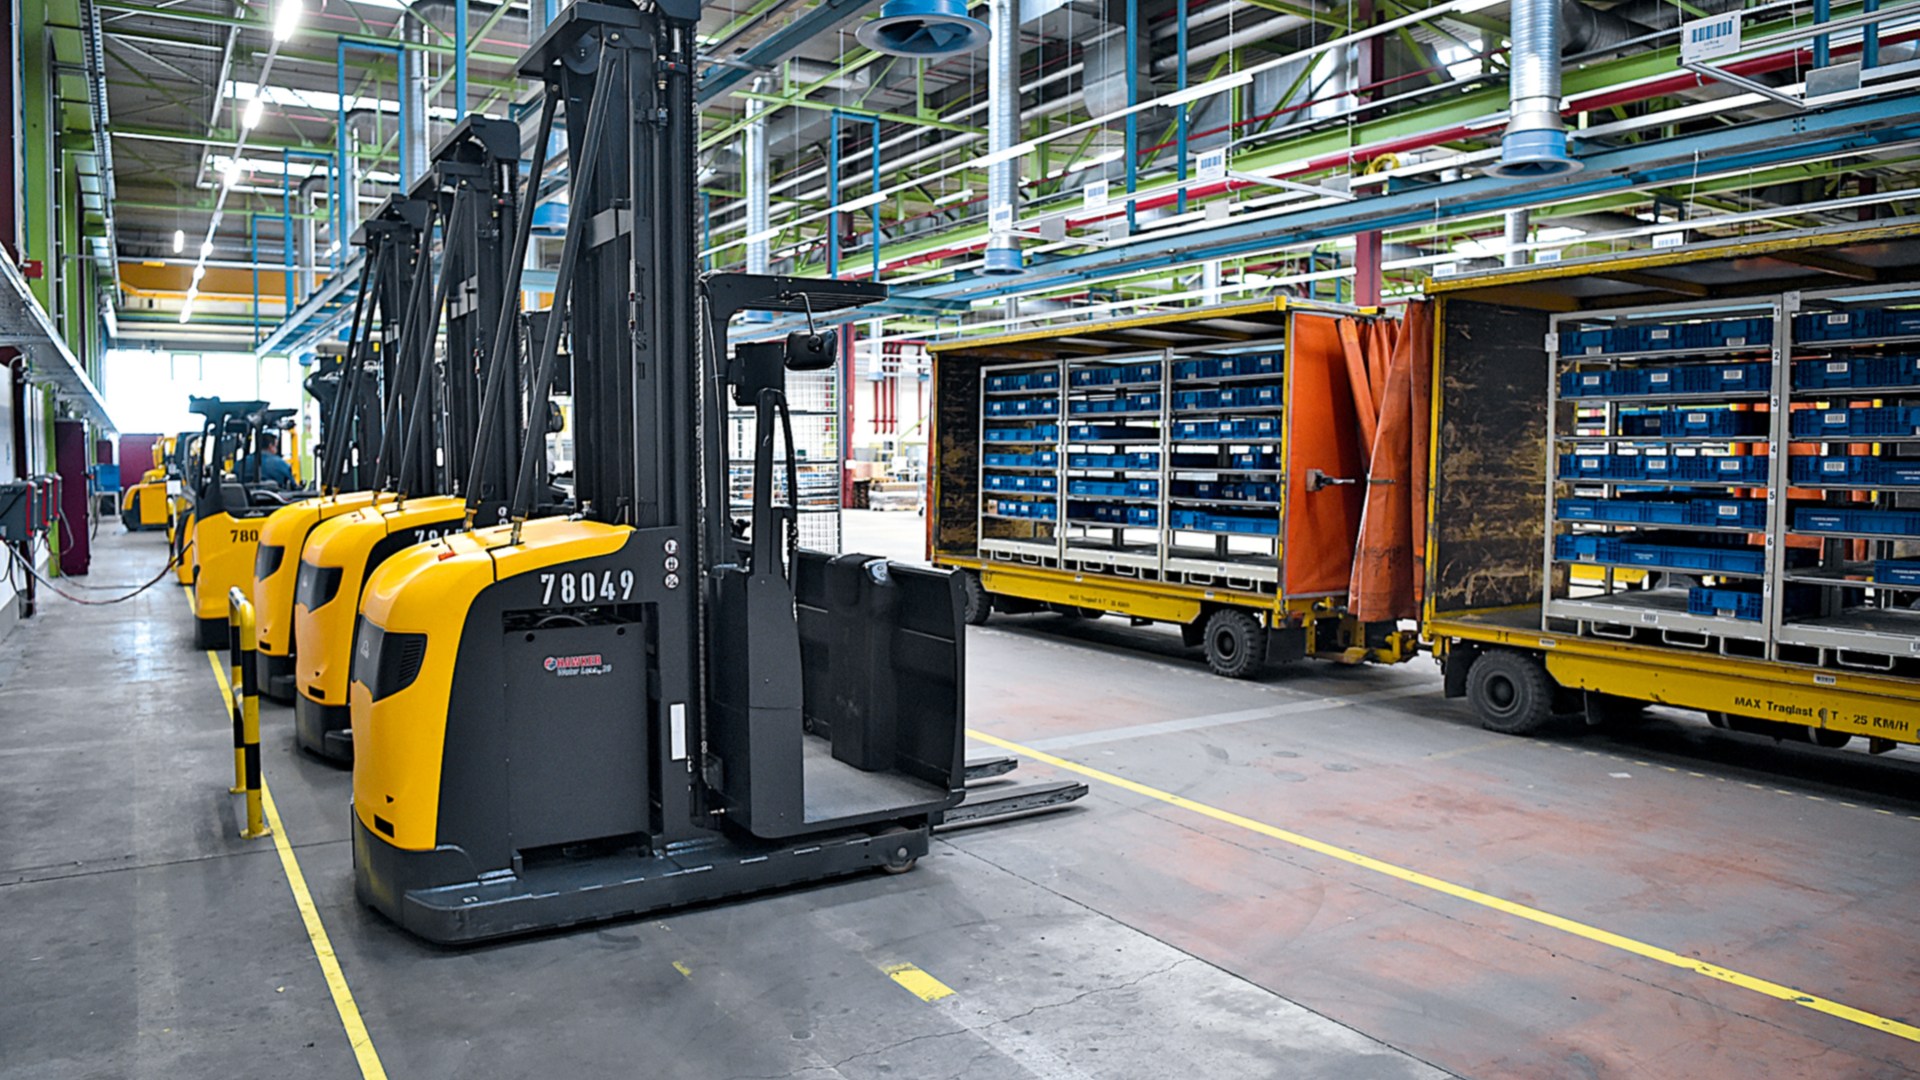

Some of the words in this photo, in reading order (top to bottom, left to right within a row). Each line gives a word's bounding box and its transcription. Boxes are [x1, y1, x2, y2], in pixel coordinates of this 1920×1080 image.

[1775, 308, 1780, 316] 1
[1774, 351, 1780, 360] 2
[1772, 399, 1778, 407] 3
[1771, 445, 1776, 453] 4
[1769, 491, 1775, 499] 5
[1767, 537, 1773, 546] 6
[541, 569, 634, 605] 78049
[1765, 584, 1771, 592] 7
[557, 654, 602, 668] HAWKER
[1734, 696, 1761, 709] MAX
[1766, 701, 1812, 717] Traglast
[1831, 710, 1838, 720] T
[1853, 714, 1868, 725] 25
[1873, 716, 1909, 731] KM/H
